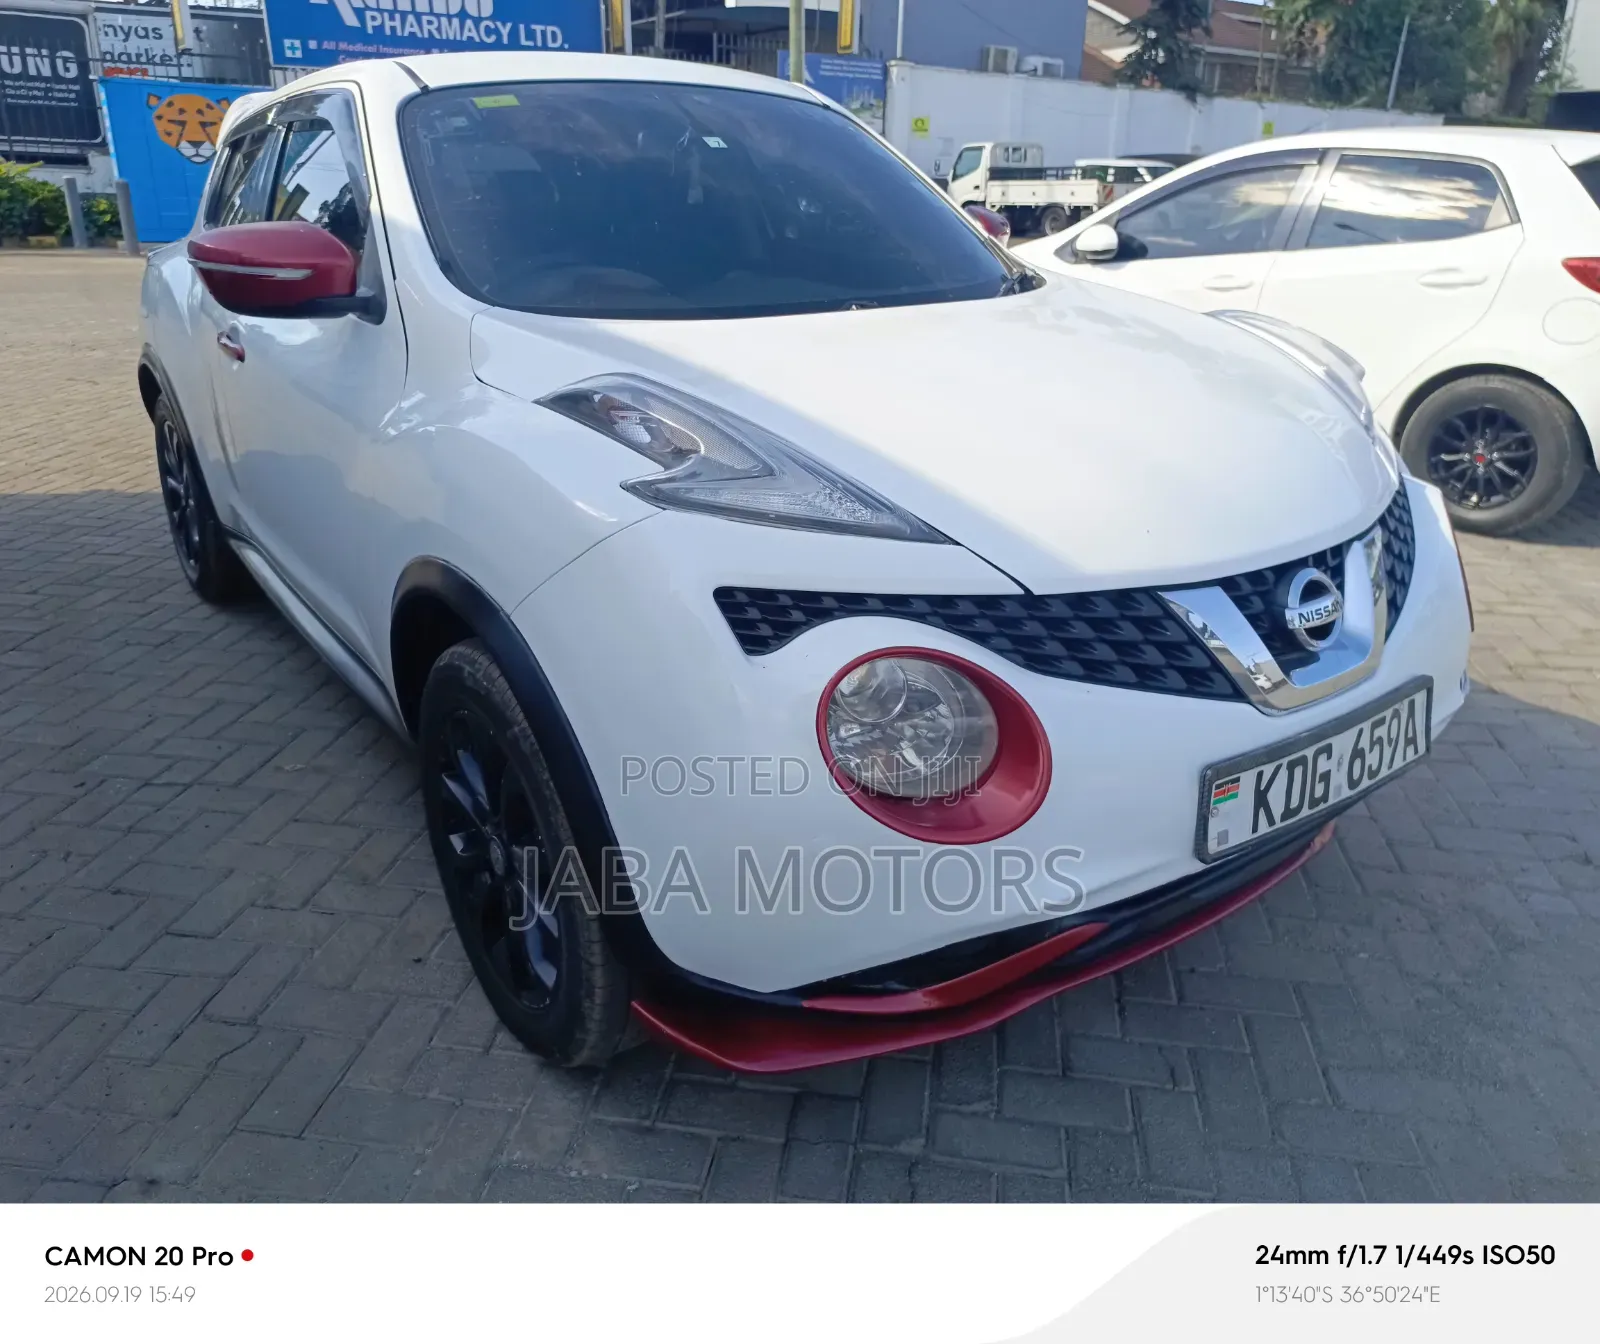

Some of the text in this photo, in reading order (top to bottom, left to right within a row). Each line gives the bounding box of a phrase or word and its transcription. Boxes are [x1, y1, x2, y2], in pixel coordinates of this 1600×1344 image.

[98, 23, 164, 43] nyas
[365, 10, 512, 45] PHARMACY
[519, 23, 569, 50] LTD.
[322, 40, 336, 50] All
[338, 42, 378, 53] Medical
[0, 45, 79, 79] UNG
[1298, 599, 1341, 625] NISSAN
[1251, 698, 1419, 835] KDG 659A
